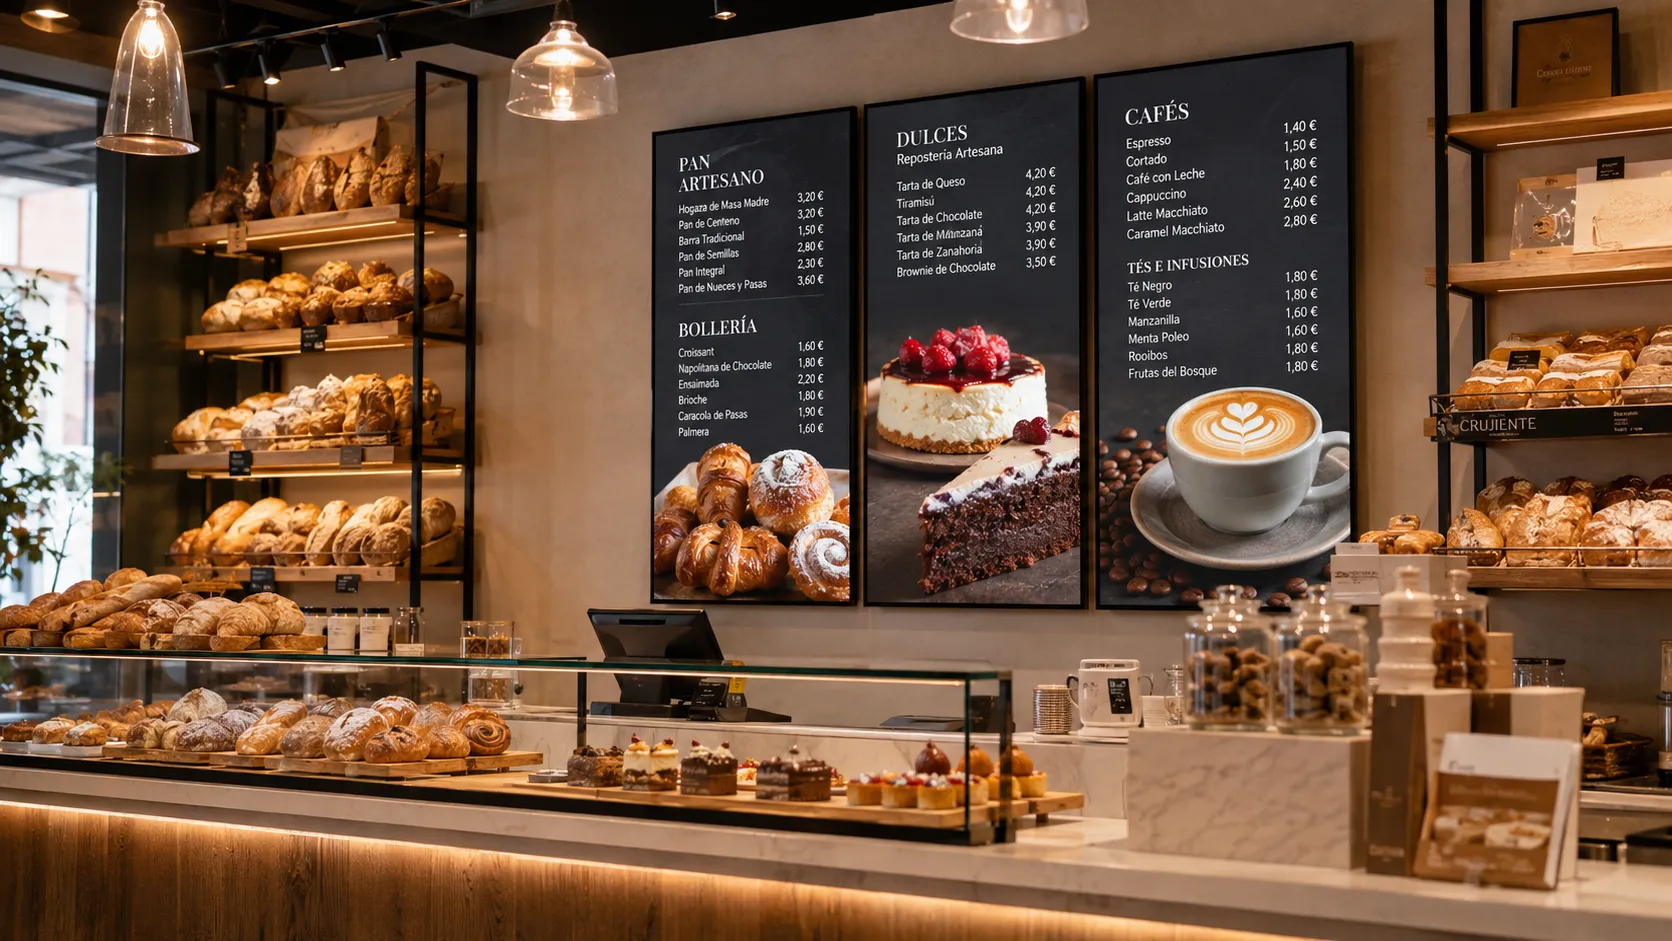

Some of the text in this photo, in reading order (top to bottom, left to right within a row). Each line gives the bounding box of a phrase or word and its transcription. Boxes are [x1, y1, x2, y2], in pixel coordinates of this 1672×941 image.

[1126, 100, 1189, 126] CAFÉS
[897, 125, 968, 148] DULCES
[1127, 120, 1317, 151] Espresso 1,40 €
[680, 154, 710, 172] PAN
[897, 146, 1003, 167] Repostería Artesana
[1126, 138, 1317, 167] Cortado 1,50 €
[679, 169, 764, 192] ARTESANO
[897, 167, 1056, 192] Tarta de Queso 4,20 €
[1126, 157, 1317, 185] Café con Leche 1,80 €
[897, 184, 1056, 209] Tiramisú 4,20 €
[1127, 175, 1318, 204] Cappuccino 2,40 €
[679, 190, 824, 216] Hogaza de Masa Madre 3,20 €
[897, 202, 1056, 226] Tarta de Chocolate 4,20 €
[1127, 195, 1318, 222] Latte Macchiato 2,60 €
[679, 207, 824, 230] Pan de Centeno 3,20 €
[1127, 214, 1318, 240] Caramel Macchiato 2,80 €
[679, 224, 824, 246] Barra Tradicional 1,50 €
[897, 233, 920, 243] Tarta
[922, 231, 934, 241] de
[1026, 221, 1046, 234] 3,90
[1049, 220, 1056, 230] €
[679, 240, 824, 262] Pan de Semillas 2,80 €
[897, 250, 920, 260] Tarta
[922, 248, 934, 258] de
[1026, 238, 1046, 251] 3,90
[1049, 238, 1056, 248] €
[679, 257, 824, 278] Pan Integral 2,30 €
[897, 256, 1056, 278] Brownie de Chocolate 3,50 €
[1127, 254, 1249, 274] TÉS E INFUSIONES
[679, 274, 824, 294] Pan de Nueces y Pasas 3,60 €
[1128, 270, 1318, 293] Té Negro 1,80 €
[1128, 288, 1318, 310] Té Verde 1,80 €
[679, 315, 757, 338] BOLLERÍA
[1128, 306, 1318, 327] Manzanilla 1,60 €
[1129, 324, 1318, 344] Menta Poleo 1,60 €
[678, 340, 824, 358] Croissant 1,60 €
[1129, 342, 1318, 361] Rooibos 1,80 €
[721, 362, 731, 372] de
[732, 360, 772, 371] Chocolate
[799, 358, 816, 368] 1,80
[818, 357, 824, 367] €
[1129, 360, 1318, 379] Frutas del Bosque 1,80 €
[679, 374, 824, 390] Ensaimada 2,20 €
[679, 390, 824, 405] Brioche 1,80 €
[678, 406, 824, 421] Caracola de Pasas 1,90 €
[1460, 417, 1536, 432] CRUJIENTE
[679, 423, 824, 437] Palmera 1,60 €
